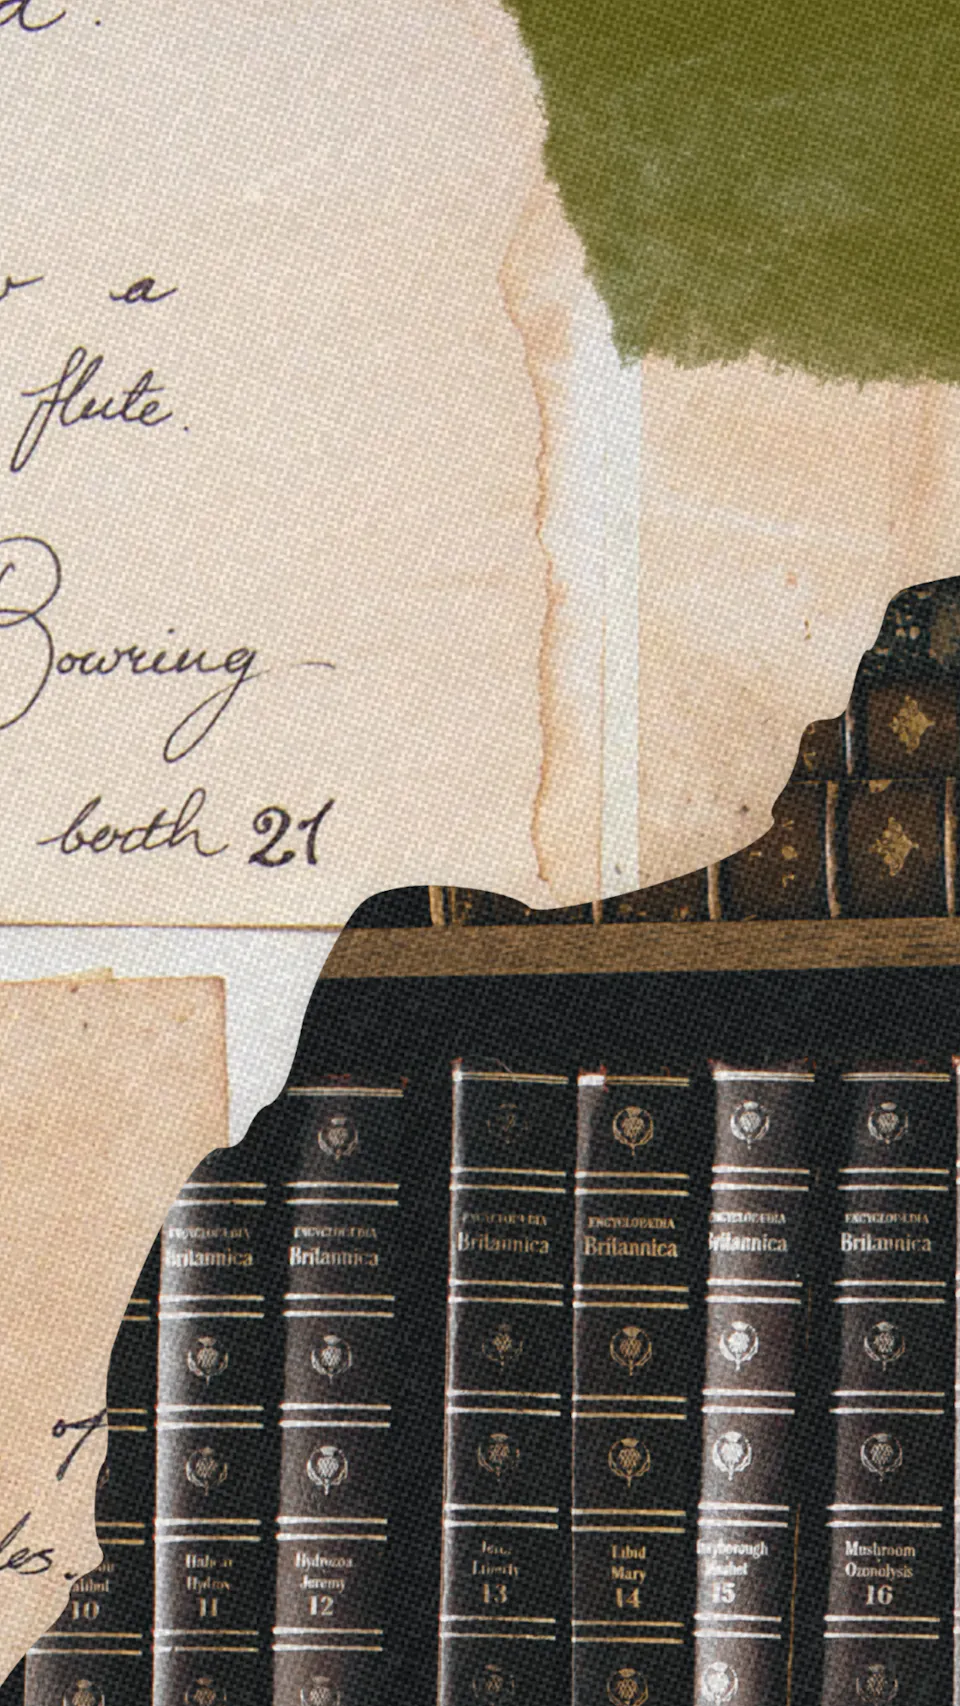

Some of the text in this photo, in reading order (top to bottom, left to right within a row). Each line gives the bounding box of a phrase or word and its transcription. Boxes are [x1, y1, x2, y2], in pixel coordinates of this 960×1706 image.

[109, 277, 178, 303] a
[10, 346, 191, 471] flute.
[248, 799, 336, 867] 21
[456, 1230, 551, 1255] Britannica
[583, 1234, 679, 1258] Britannica
[840, 1231, 934, 1253] Britannica
[844, 1540, 917, 1559] Mushroom
[293, 1552, 354, 1571] Hydrozoa
[844, 1561, 914, 1580] Ozonolysis
[611, 1565, 648, 1583] Mary
[482, 1582, 508, 1604] 13
[614, 1586, 641, 1610] 14
[711, 1581, 736, 1604] 15
[865, 1585, 894, 1606] 16
[71, 1600, 100, 1620] 10
[198, 1597, 219, 1619] 11
[308, 1596, 335, 1617] 12
